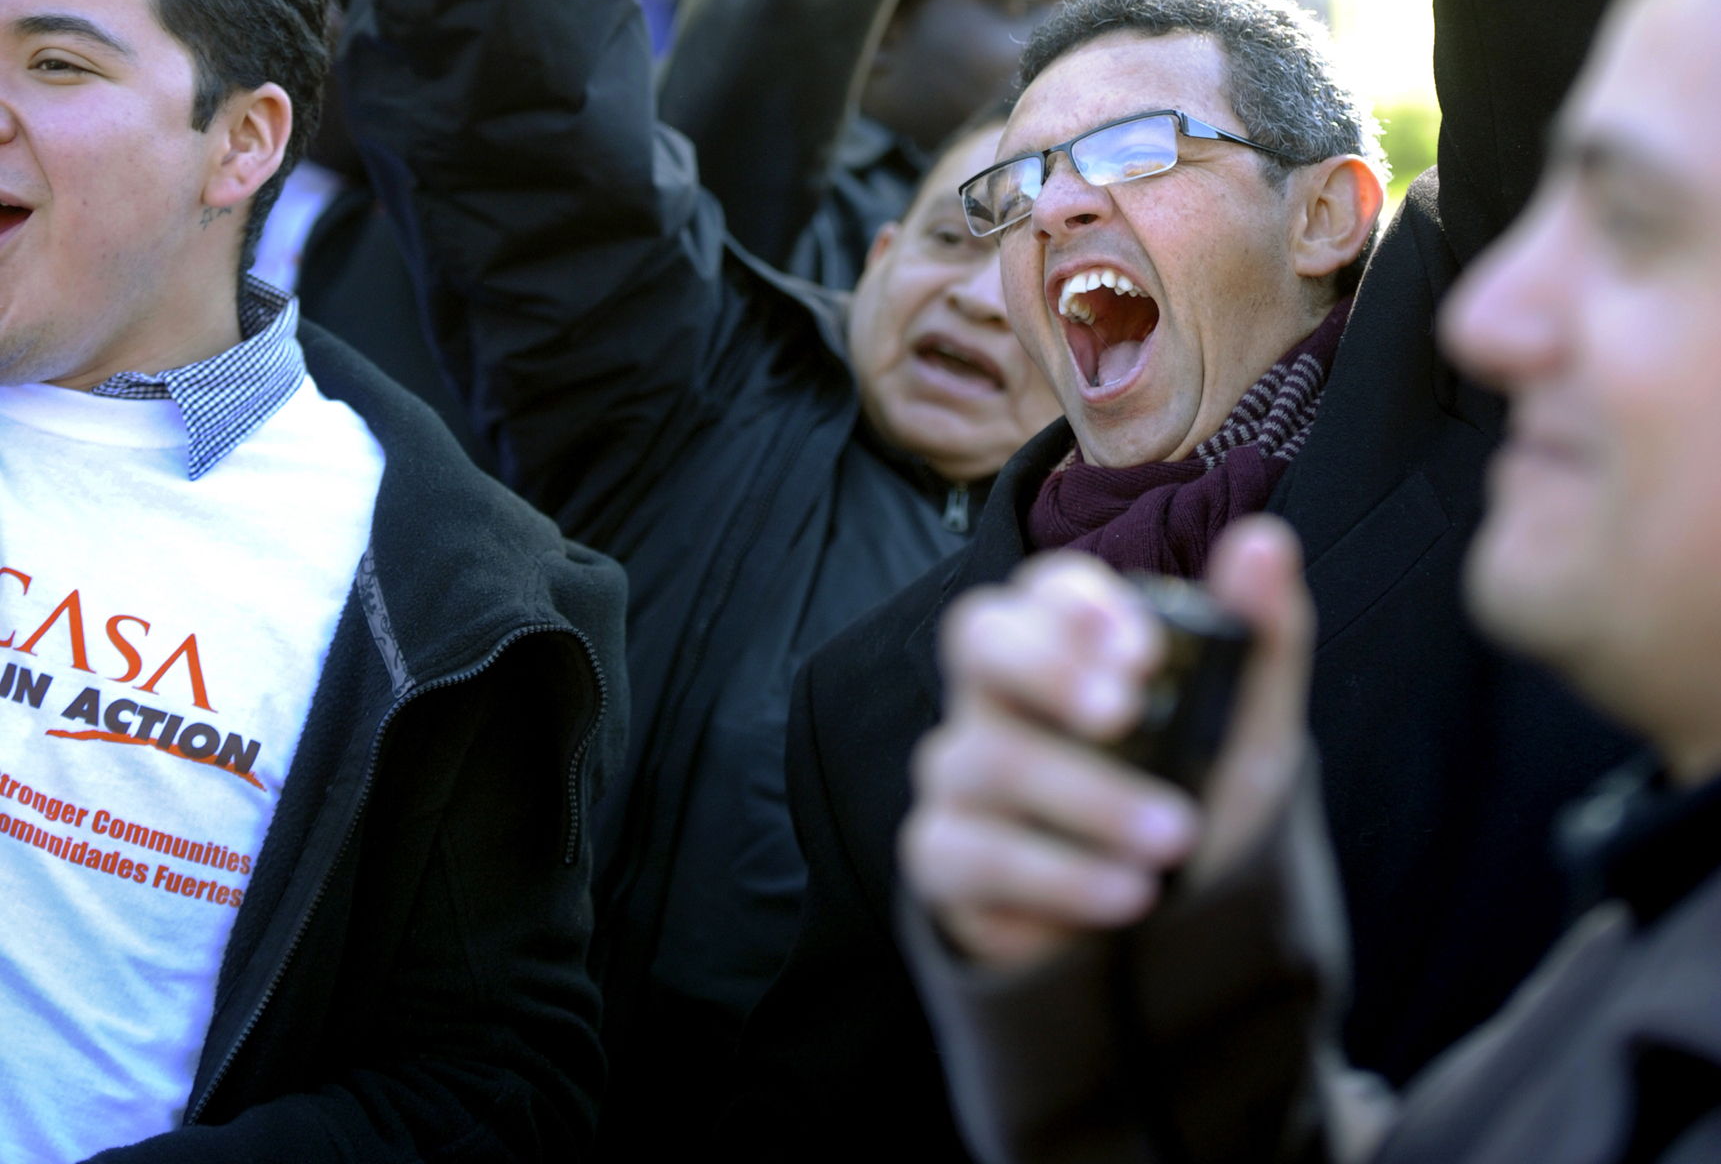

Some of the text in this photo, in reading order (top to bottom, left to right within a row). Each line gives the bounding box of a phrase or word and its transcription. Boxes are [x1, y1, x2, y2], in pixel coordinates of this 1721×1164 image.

[0, 662, 261, 773] IN ACTION
[0, 772, 251, 874] tronger Communities
[0, 812, 243, 908] omunidades Fuertes
